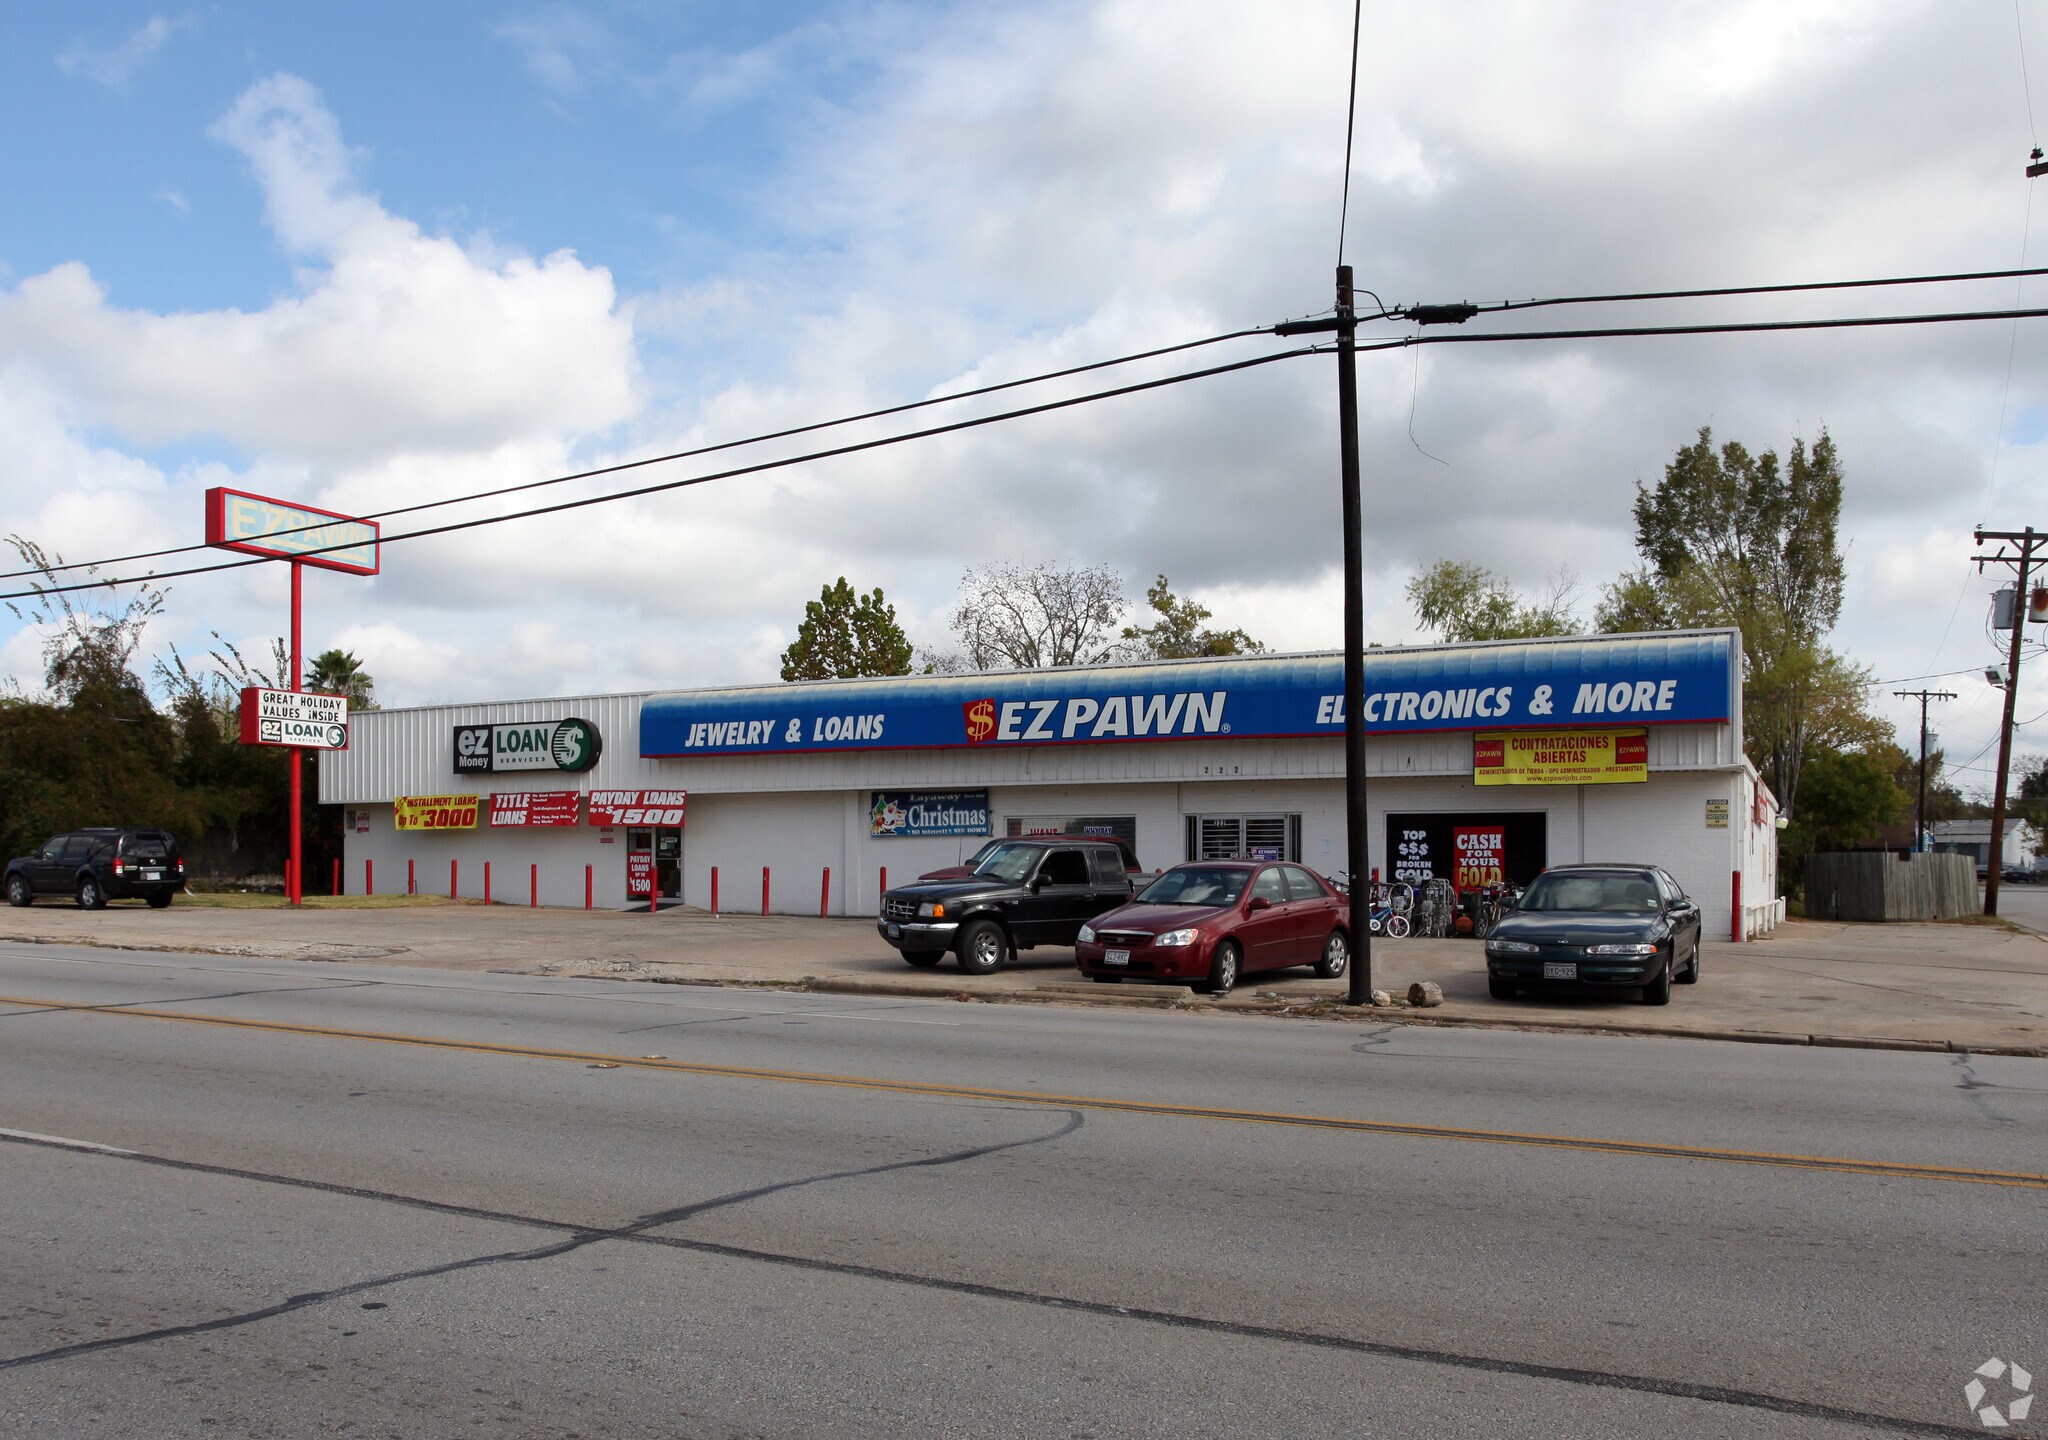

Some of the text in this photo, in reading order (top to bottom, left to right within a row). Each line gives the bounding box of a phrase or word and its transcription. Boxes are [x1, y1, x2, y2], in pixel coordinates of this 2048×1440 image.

[263, 692, 341, 710] GREAT HOLIDAY
[1315, 679, 1678, 724] ELCTRONICS & MORE
[263, 706, 300, 718] VALUES
[285, 723, 323, 738] LOAN
[684, 714, 885, 747] JEWELRY & LOANS
[262, 734, 281, 742] Money
[458, 729, 489, 756] ez
[496, 728, 548, 754] LOAN
[1511, 735, 1609, 751] CONTRATACIONES
[1476, 750, 1502, 758] EZPAWN
[1619, 746, 1645, 754] EZPAWN
[459, 756, 489, 768] Money
[1533, 750, 1587, 764] ABIERTAS
[1605, 765, 1643, 773] PRESTAMISTAS
[1526, 774, 1593, 782] www.ezpawnjobs.com
[407, 797, 452, 807] INSTALLMENT
[454, 796, 477, 806] LOANS
[495, 793, 531, 808] TITLE
[590, 791, 686, 805] PAYDAY LOANS
[910, 794, 961, 803] Layaway
[398, 814, 407, 827] Up
[408, 814, 418, 825] To
[491, 810, 529, 825] LOANS
[908, 804, 986, 827] Christmas
[1403, 830, 1426, 840] TOP
[1456, 834, 1502, 849] CASH
[630, 855, 651, 863] PAYDAY
[1460, 858, 1500, 866] YOUR
[631, 864, 649, 872] LOANS
[1395, 869, 1434, 880] GOLD
[1459, 866, 1502, 887] GOLD
